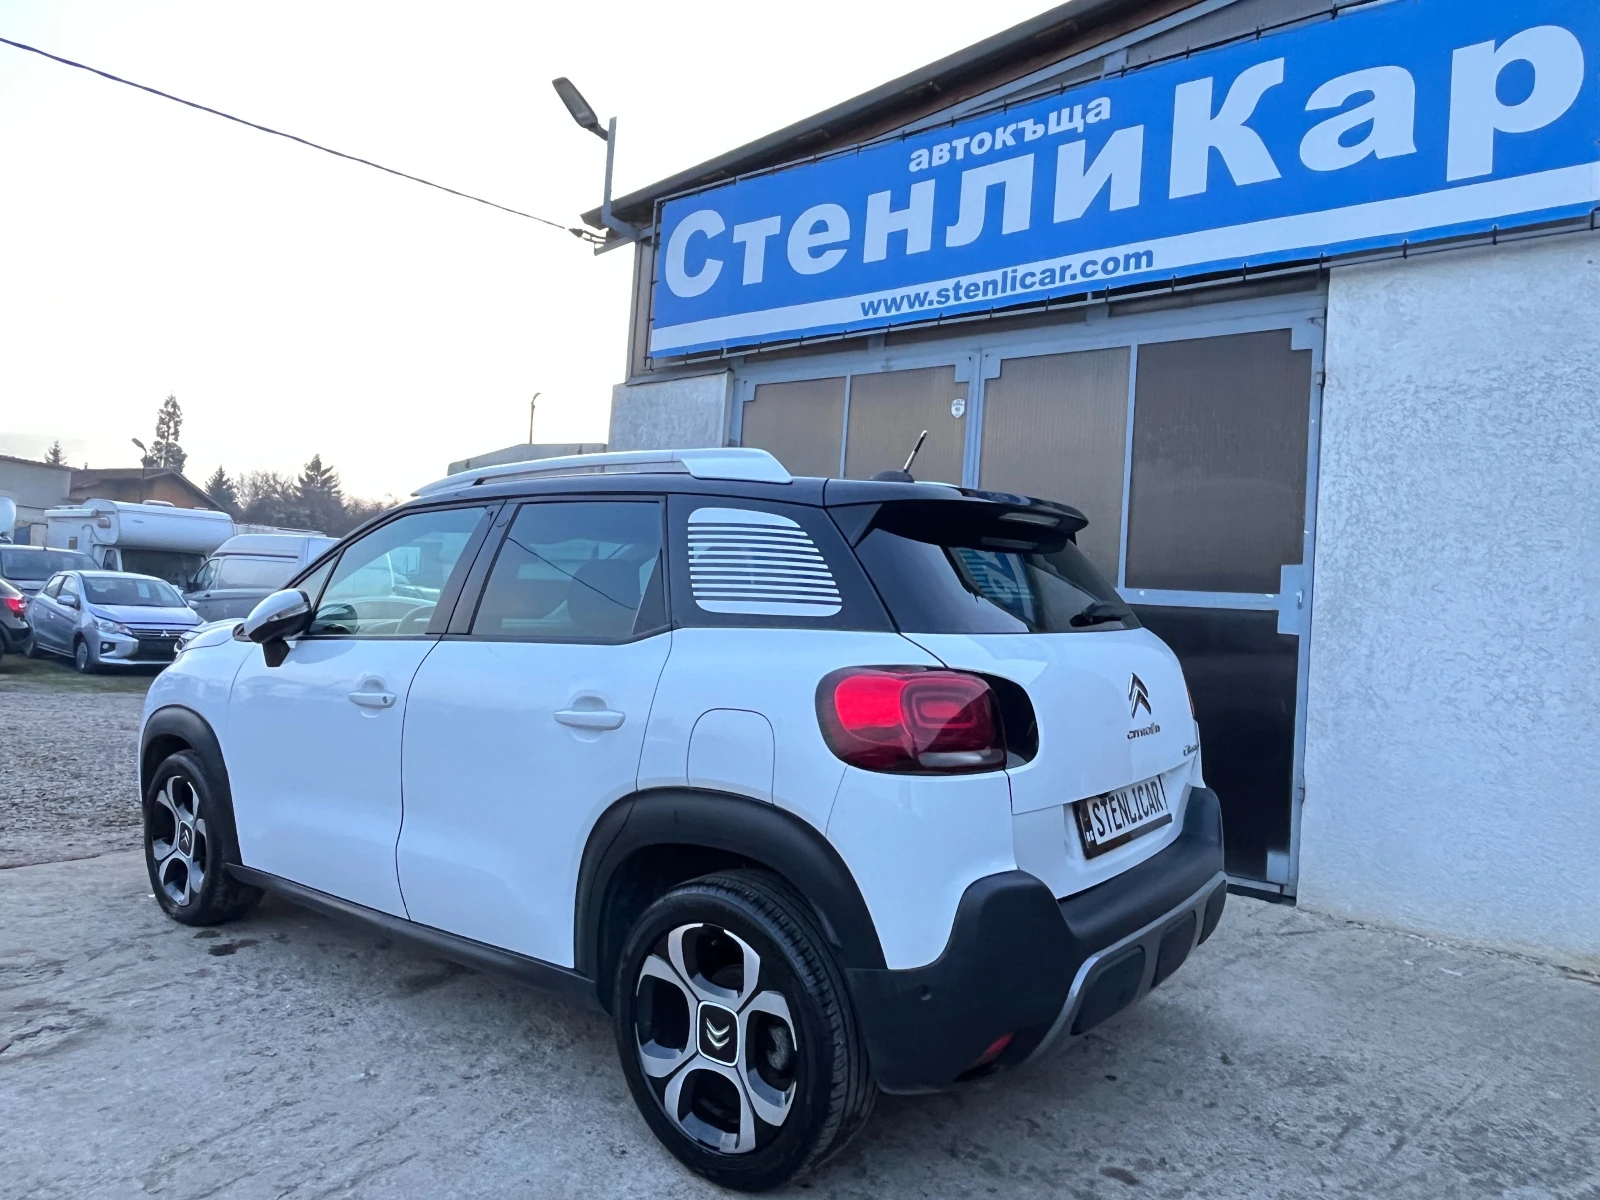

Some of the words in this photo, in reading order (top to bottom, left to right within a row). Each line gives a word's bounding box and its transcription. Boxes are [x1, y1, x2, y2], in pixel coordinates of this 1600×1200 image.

[909, 96, 1111, 173] автокъща
[860, 249, 1154, 317] www.stenlicar.com
[1092, 780, 1164, 838] STENLICAR
